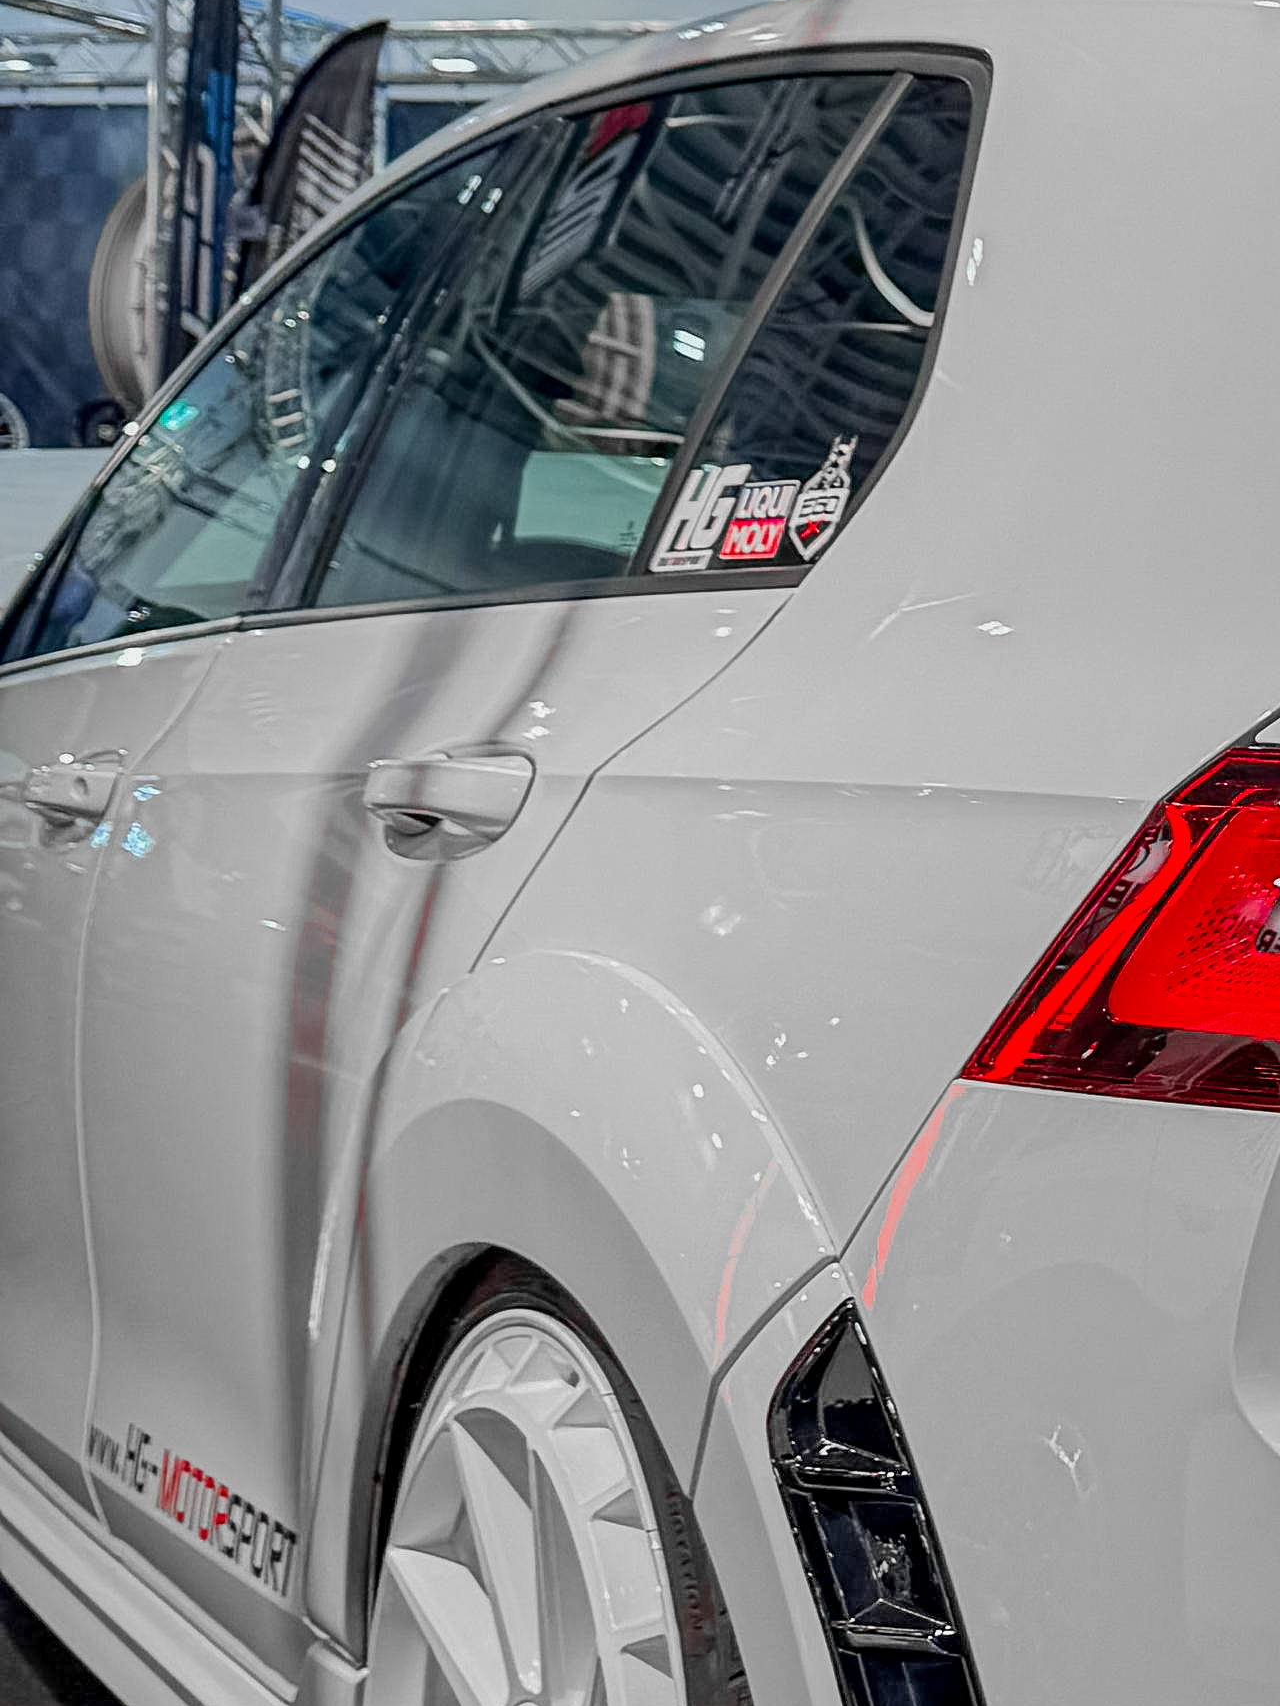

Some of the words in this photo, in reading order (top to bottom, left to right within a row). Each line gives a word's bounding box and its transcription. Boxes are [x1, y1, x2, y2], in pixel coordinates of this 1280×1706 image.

[658, 463, 752, 551] HG
[734, 484, 797, 519] LIQUI
[726, 523, 779, 555] MOLY
